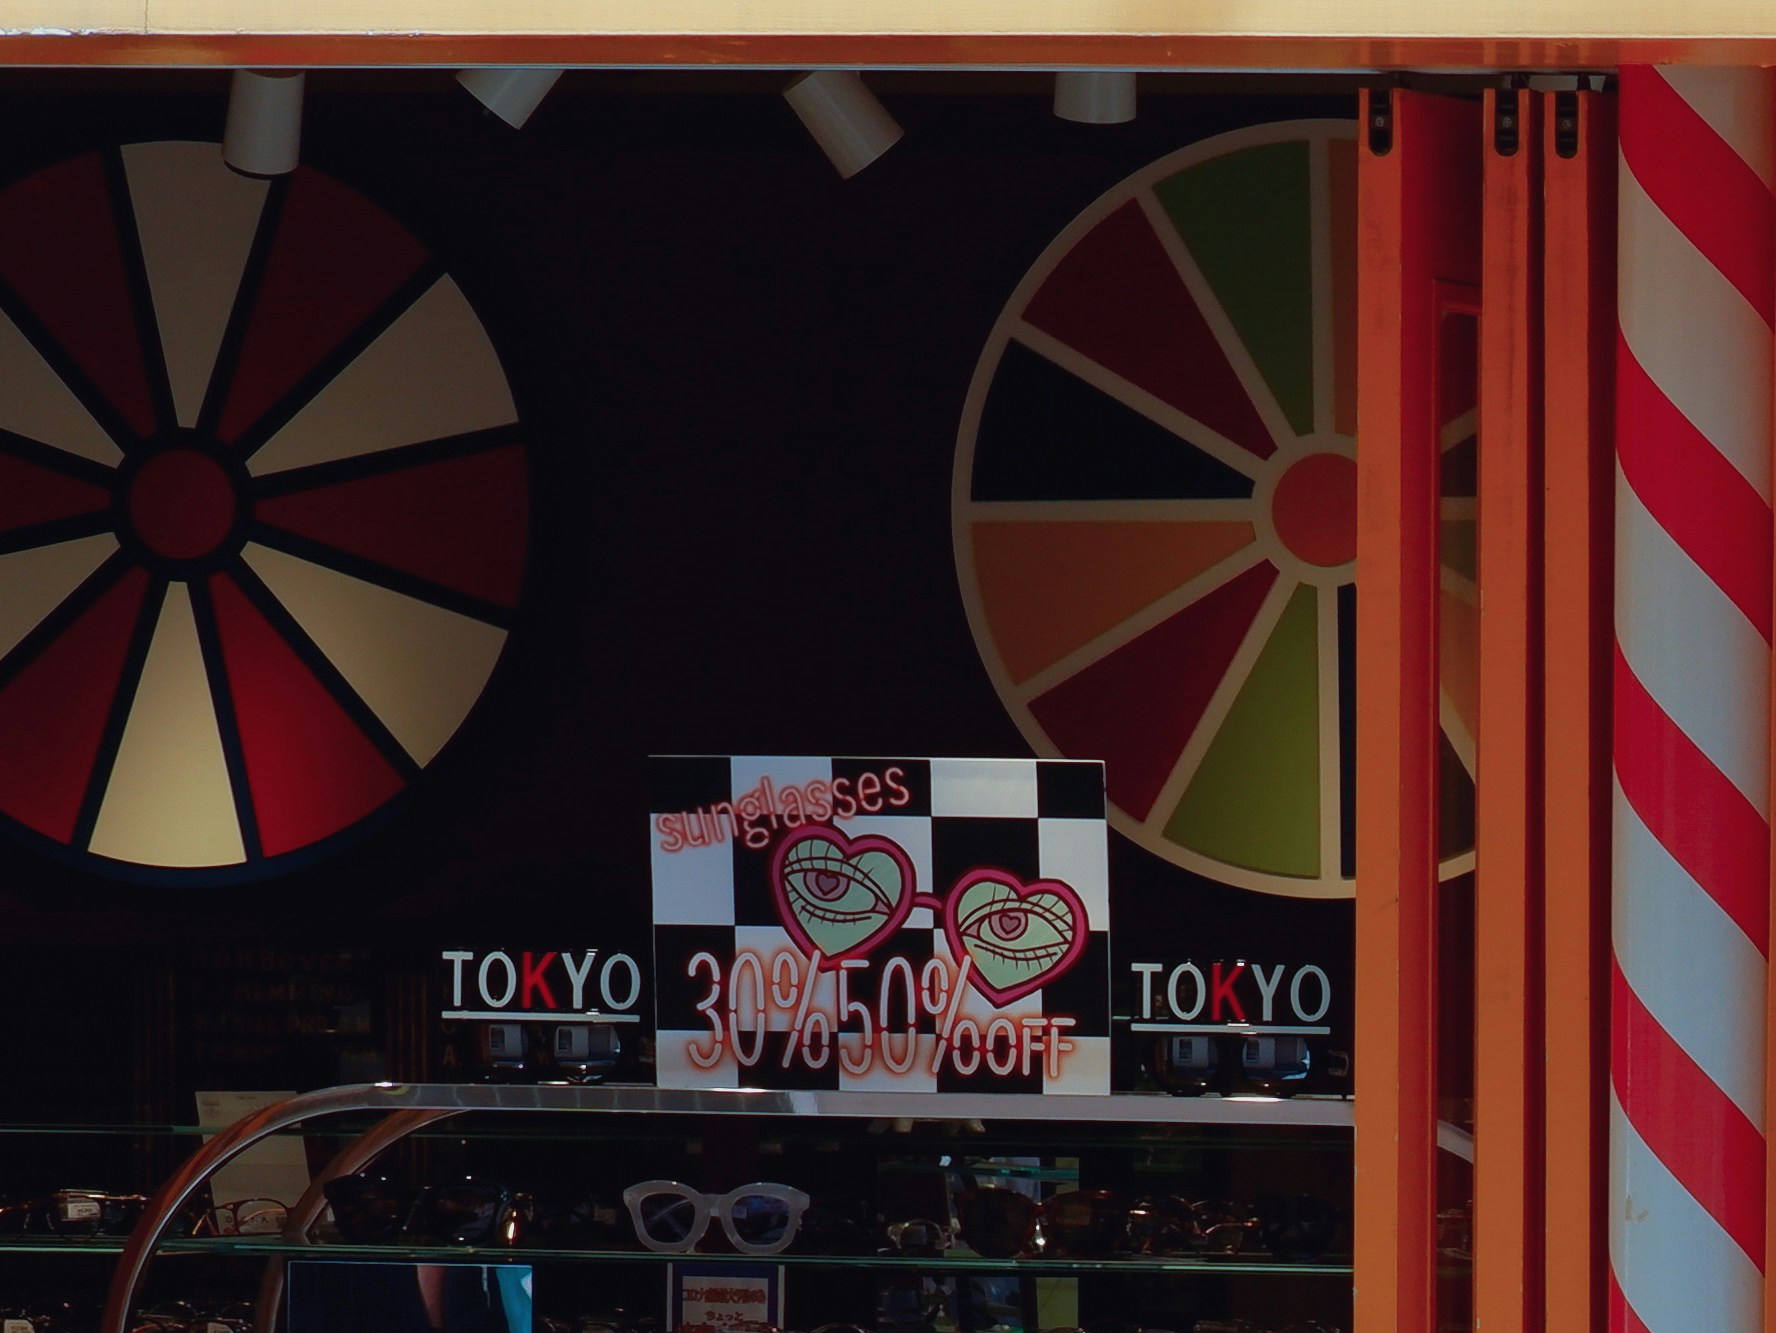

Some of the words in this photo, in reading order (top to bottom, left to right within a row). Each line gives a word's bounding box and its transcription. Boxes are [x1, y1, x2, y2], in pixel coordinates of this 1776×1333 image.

[655, 765, 911, 854] sunglasses
[442, 948, 641, 1012] TOKYO
[1129, 960, 1332, 1023] TOKYO
